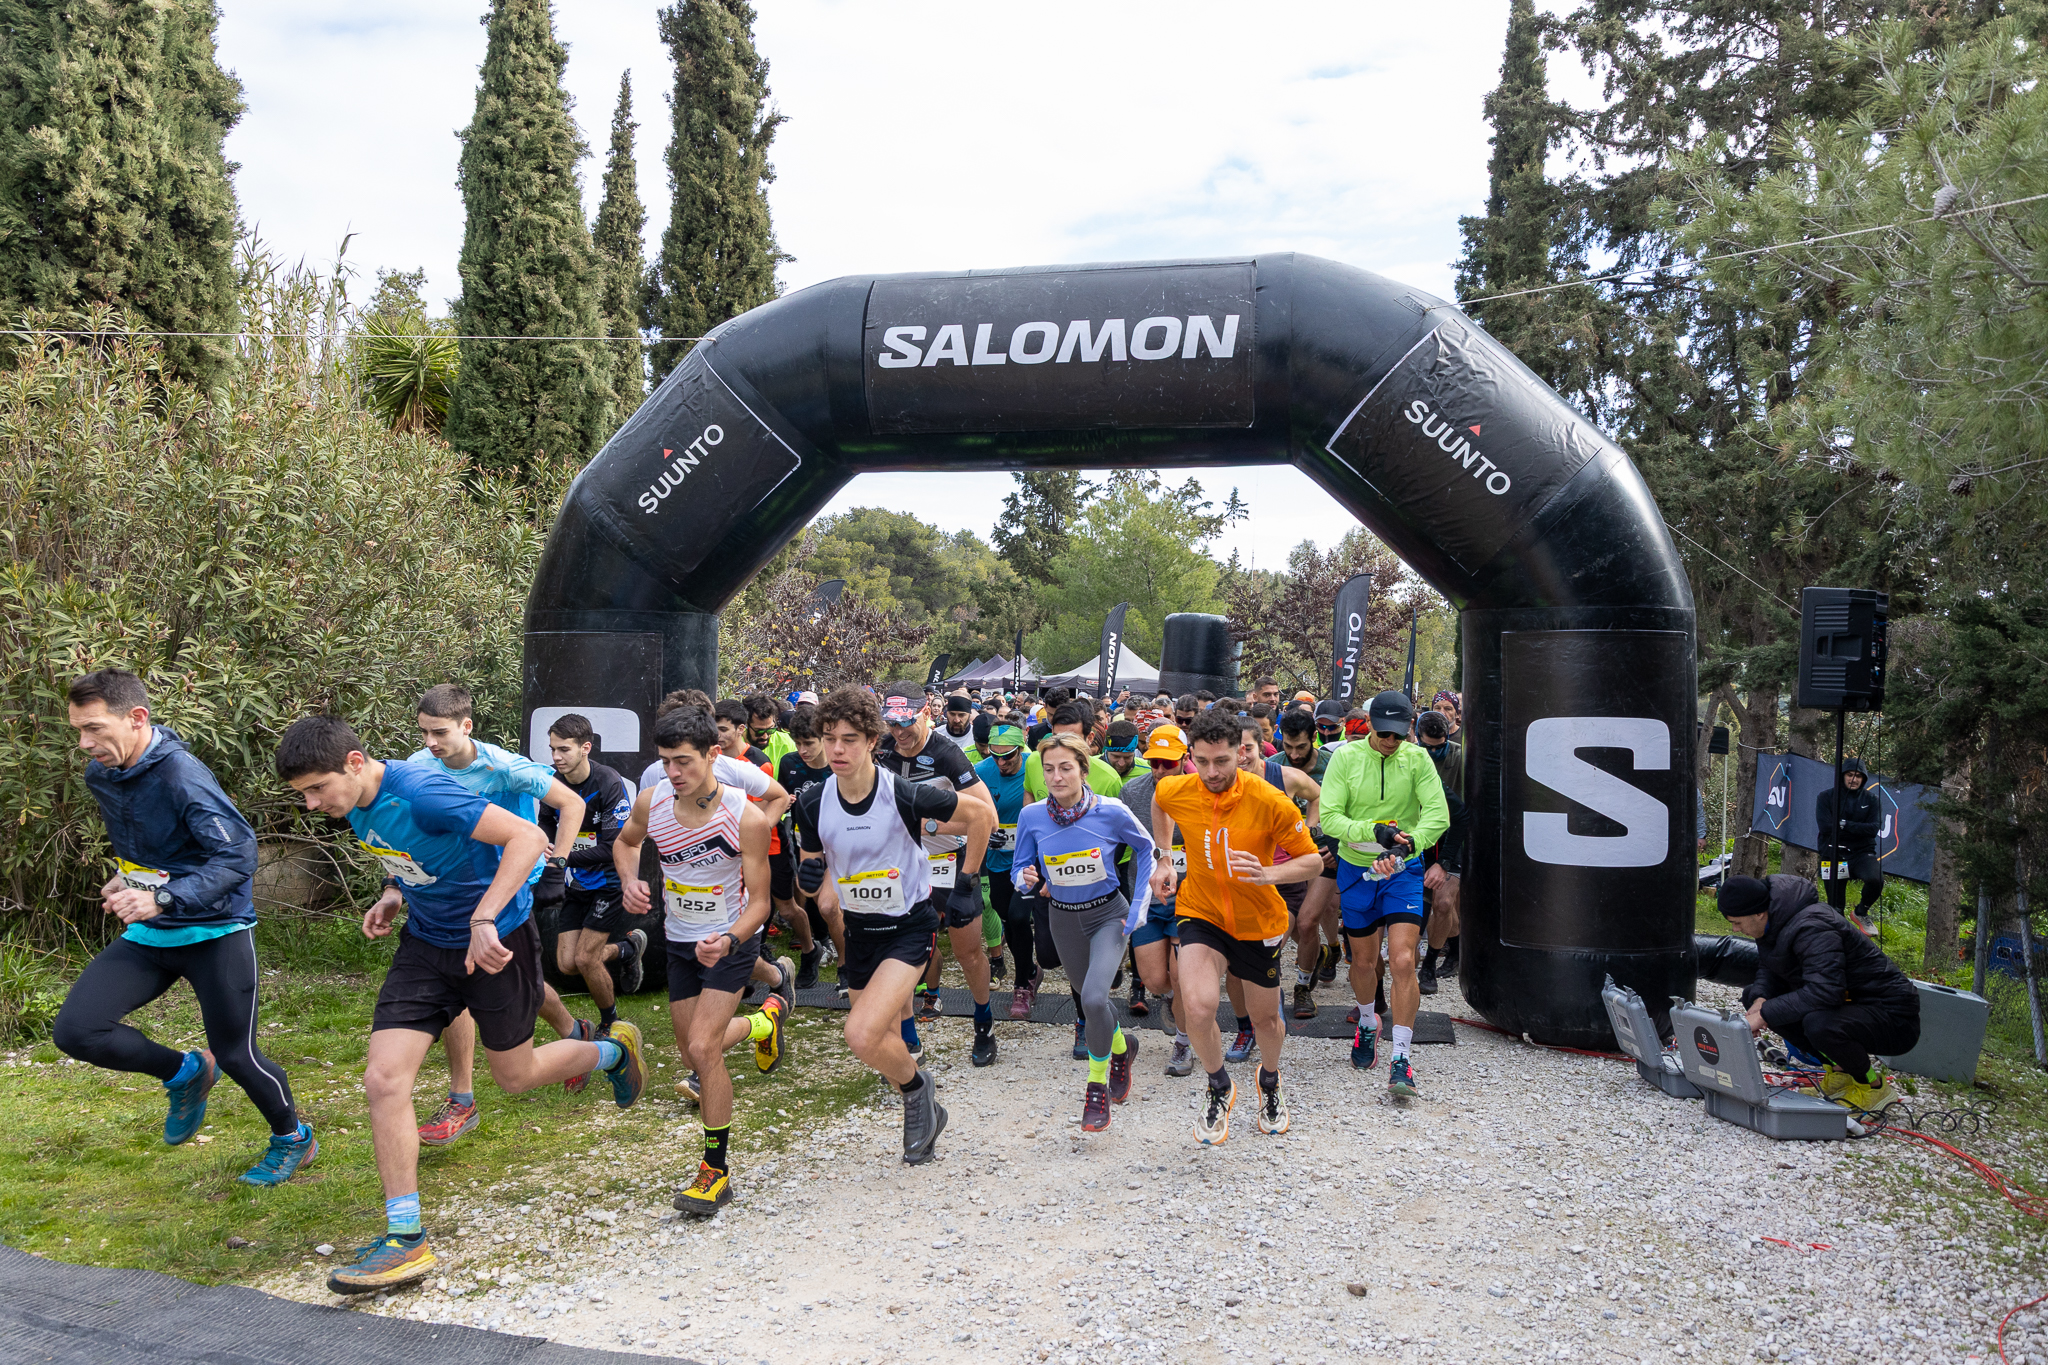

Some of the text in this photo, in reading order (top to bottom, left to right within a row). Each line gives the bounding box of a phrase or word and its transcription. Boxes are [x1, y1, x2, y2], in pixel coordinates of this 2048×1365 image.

[878, 314, 1241, 368] SALOMON
[638, 424, 724, 514] SUUNTO
[1404, 400, 1511, 495] SUUNTO
[1340, 612, 1362, 698] UUNTO
[1523, 716, 1671, 868] S
[680, 843, 708, 861] SPO
[1055, 864, 1096, 877] 1005
[676, 897, 716, 912] 1252
[850, 886, 892, 899] 1001
